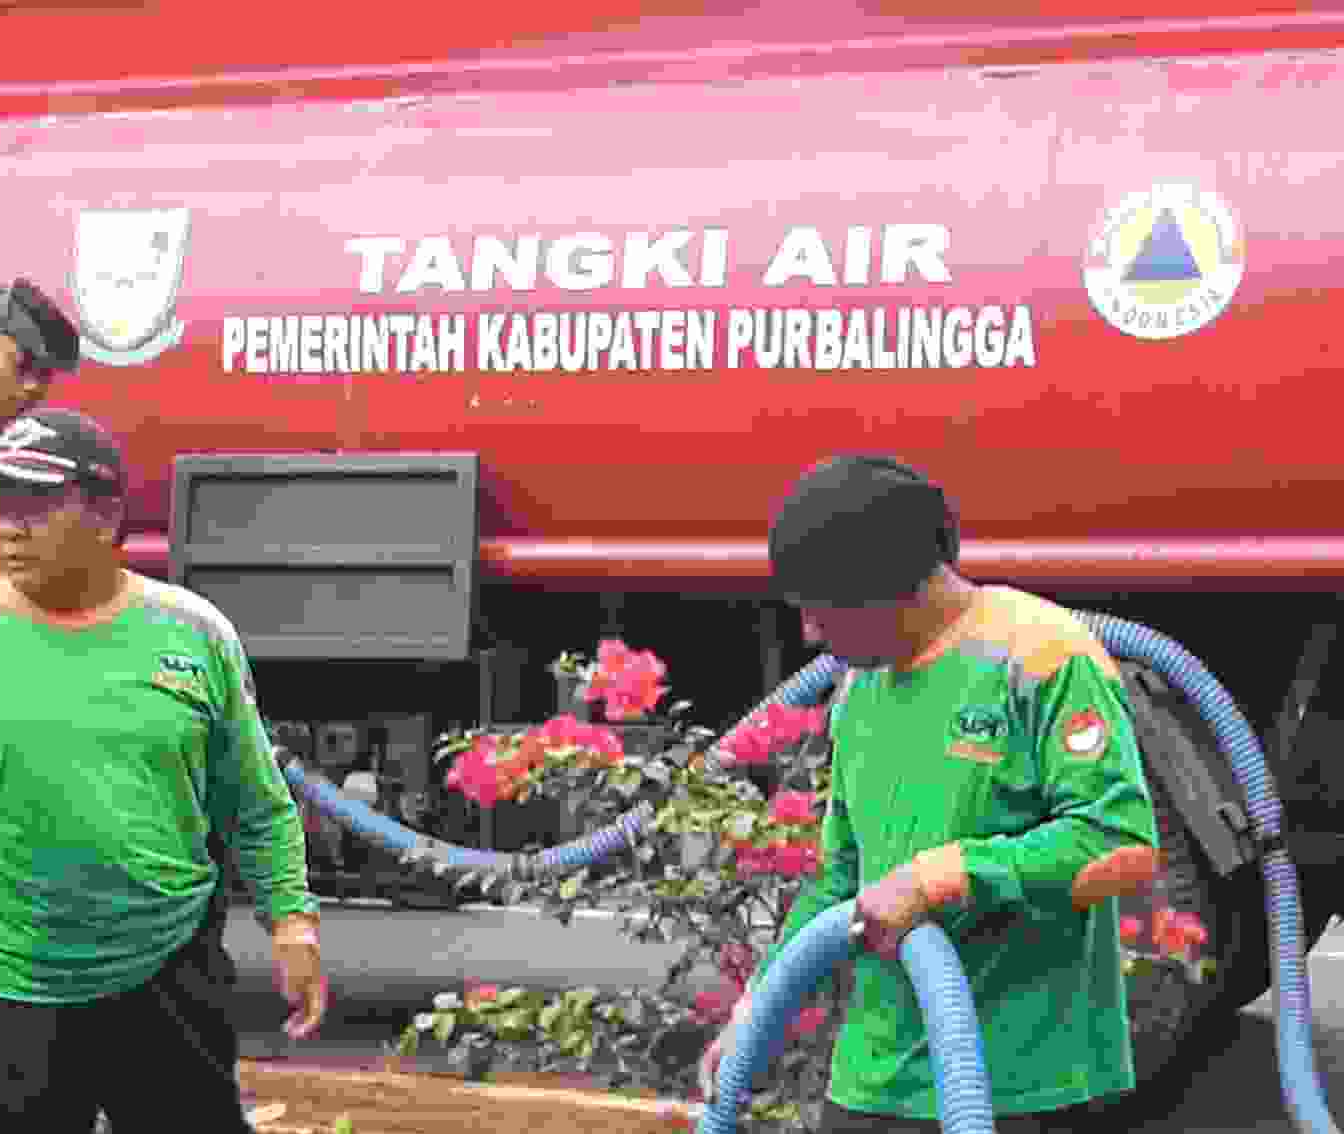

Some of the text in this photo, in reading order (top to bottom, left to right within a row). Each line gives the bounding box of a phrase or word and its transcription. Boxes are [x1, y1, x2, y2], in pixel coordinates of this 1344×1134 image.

[345, 223, 953, 294] TANGKI AIR
[223, 303, 1038, 374] PEMERINTAH KABUPATEN PURBALINGGA
